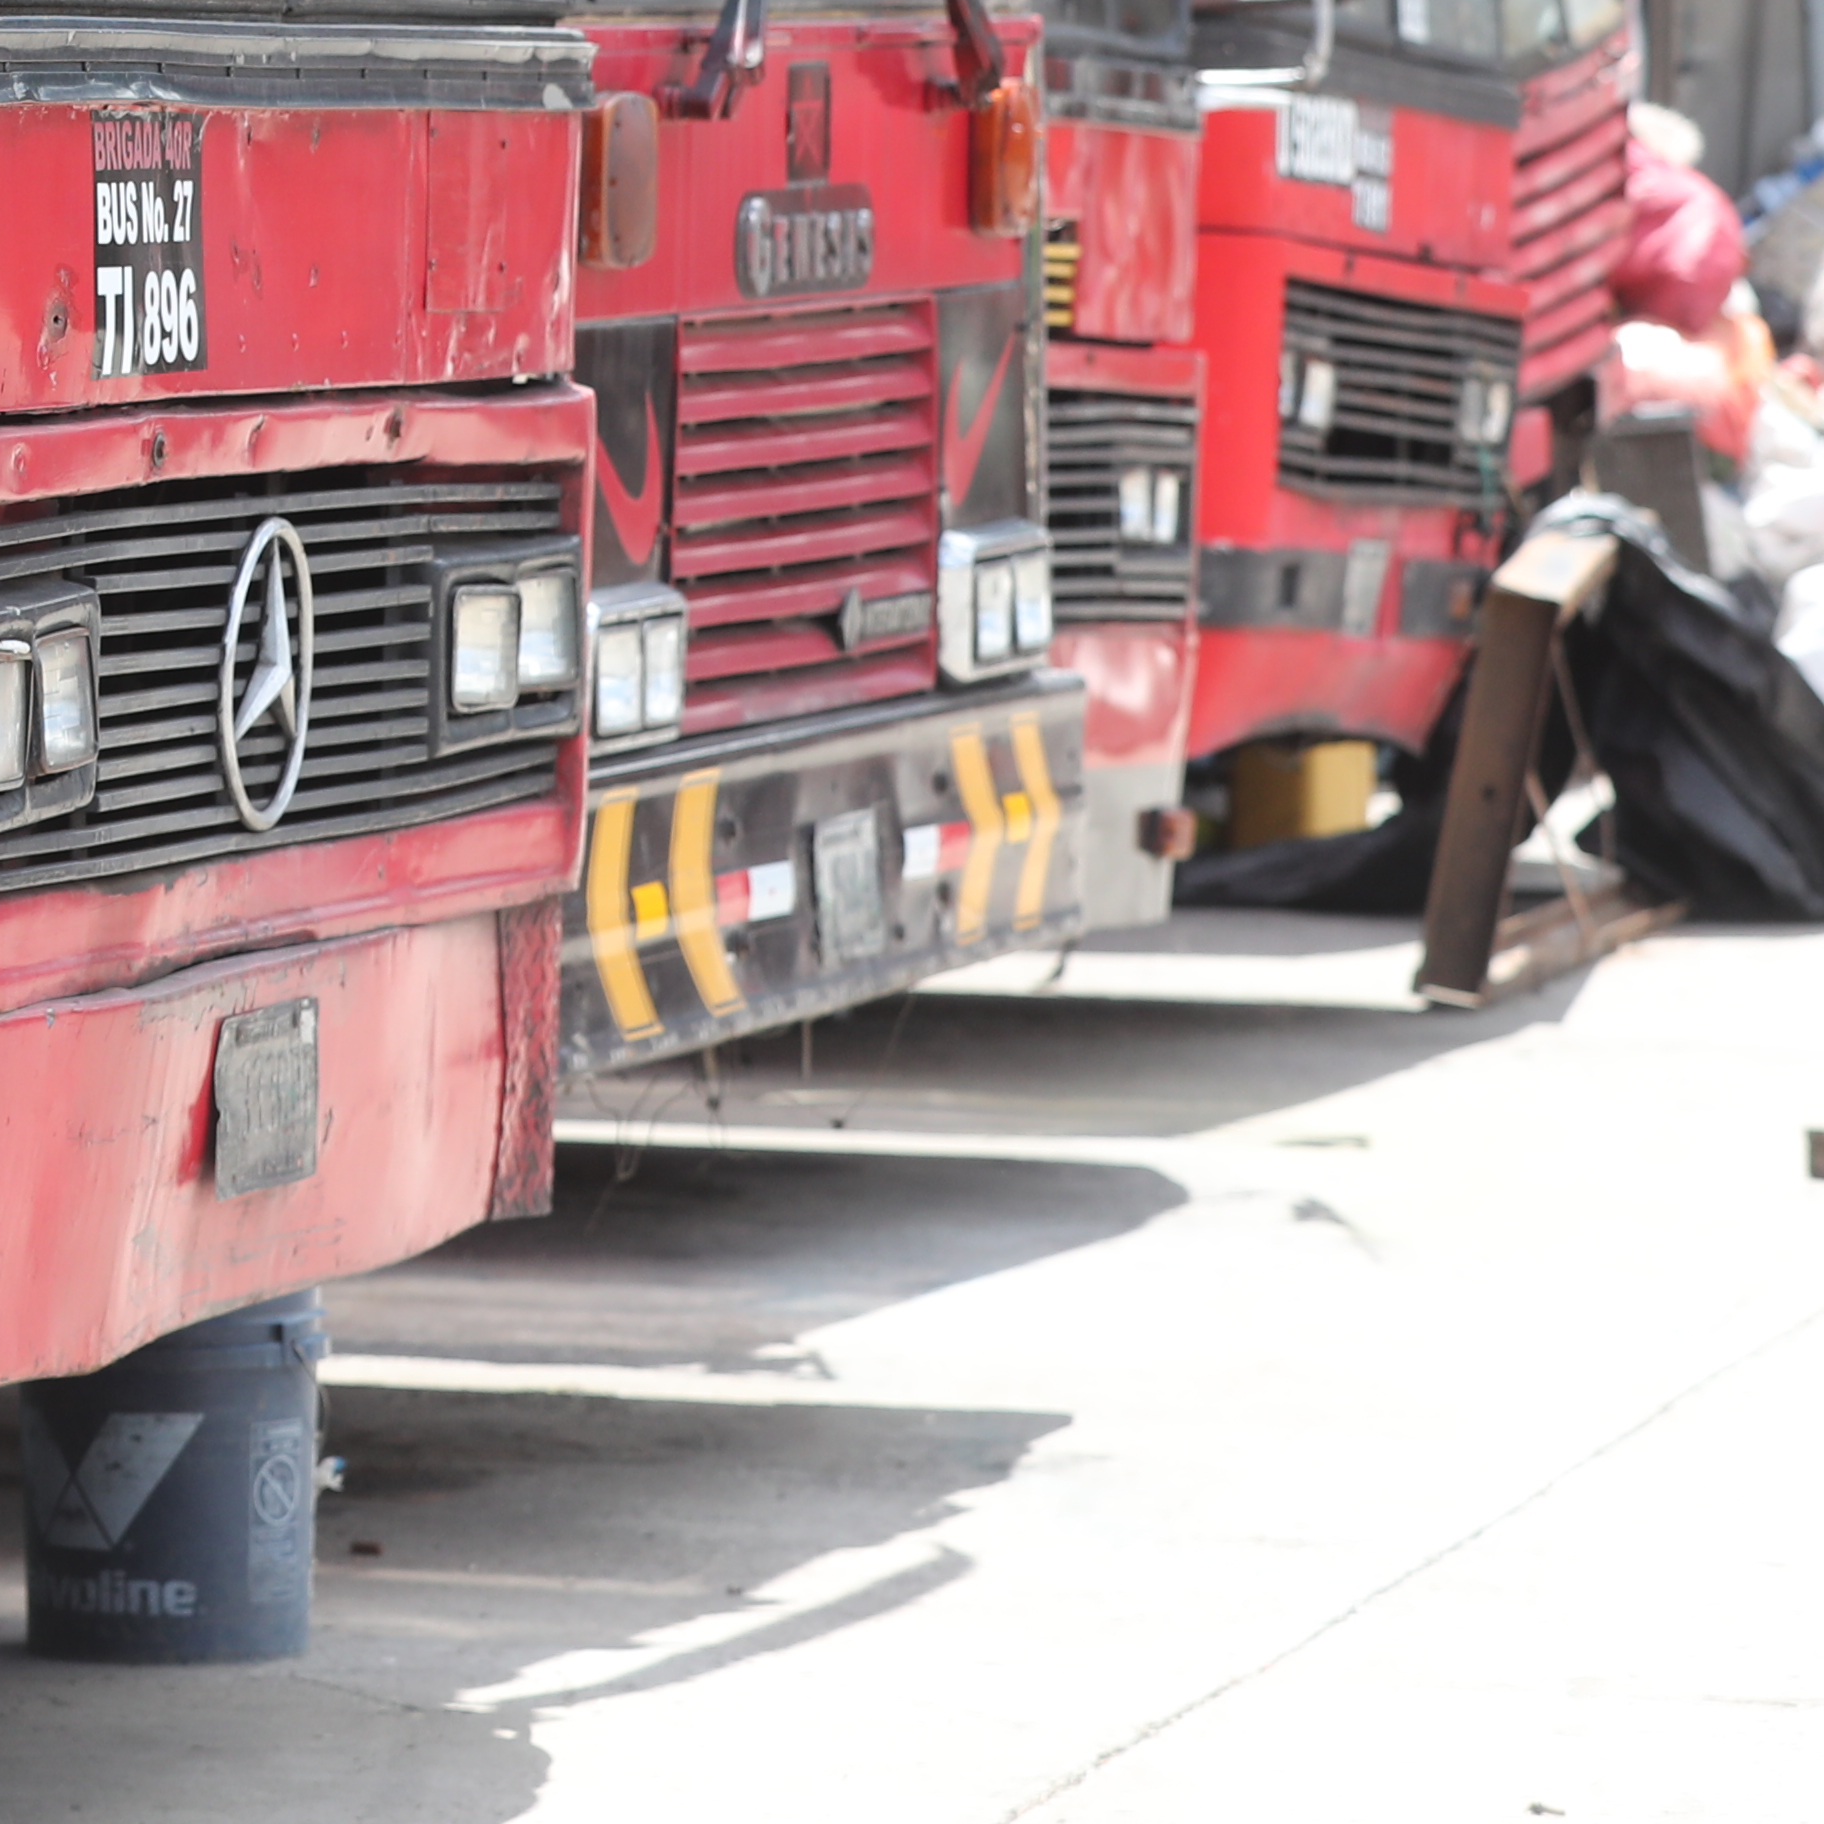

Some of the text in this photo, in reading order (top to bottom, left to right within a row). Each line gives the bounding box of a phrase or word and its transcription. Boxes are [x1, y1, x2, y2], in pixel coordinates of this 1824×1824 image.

[93, 120, 162, 171] BRIGADA
[97, 180, 194, 245] BUS No. 27
[97, 266, 199, 376] TI 896
